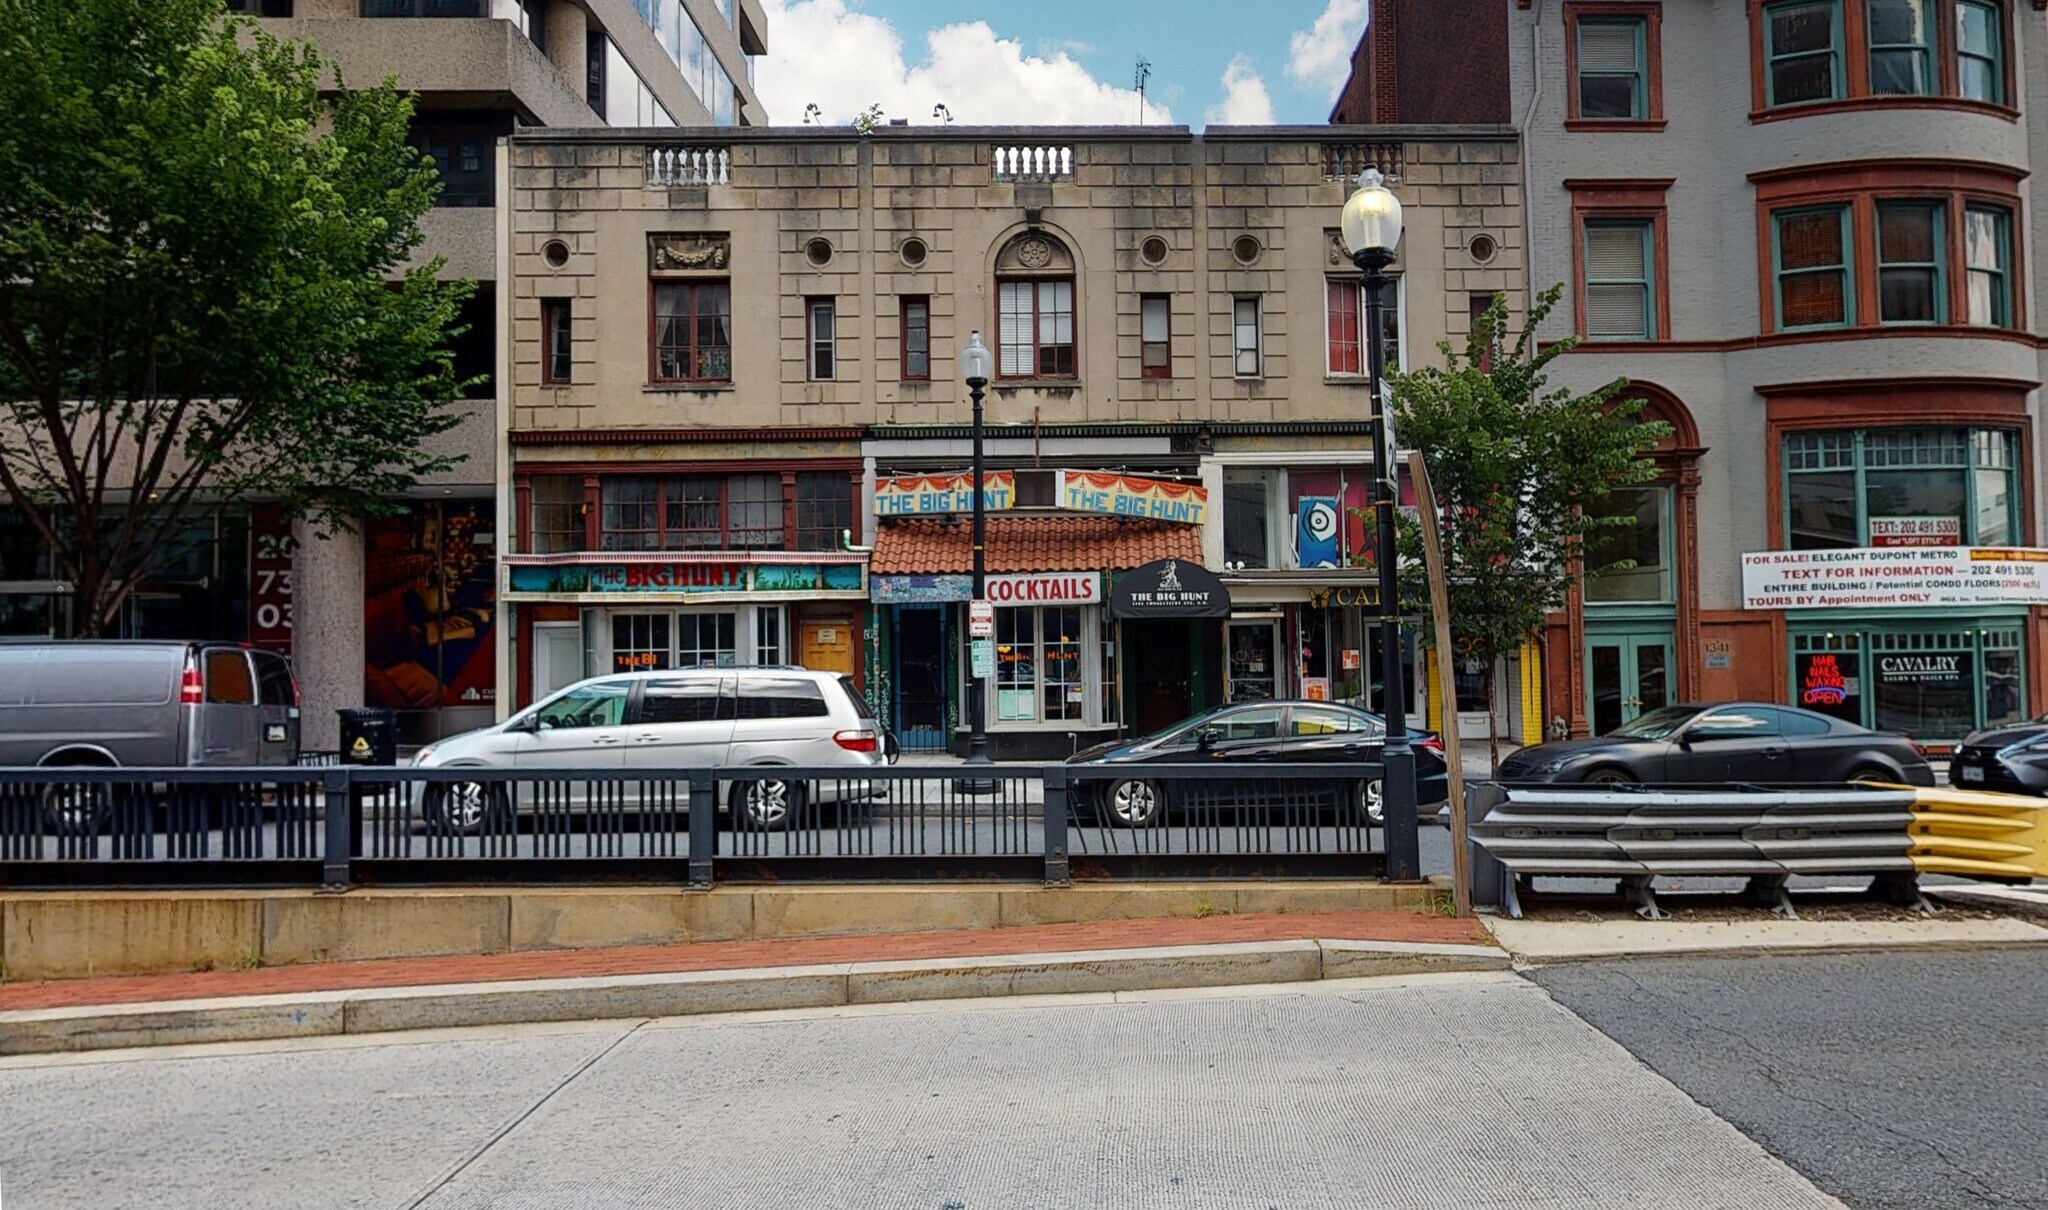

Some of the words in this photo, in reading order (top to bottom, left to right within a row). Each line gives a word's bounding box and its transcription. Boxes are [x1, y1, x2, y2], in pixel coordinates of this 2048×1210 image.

[876, 494, 914, 513] THE
[919, 492, 950, 512] BIG
[1068, 488, 1109, 513] THE
[1114, 494, 1147, 516] BIG
[1151, 499, 1203, 523] HUNT
[1872, 521, 1898, 534] TEXT:
[1901, 520, 1916, 533] 202
[1745, 556, 1770, 565] FOR
[1774, 554, 1809, 564] SALE!
[1812, 552, 1866, 562] ELEGANT
[1870, 551, 1917, 560] DUPONT
[1921, 550, 1958, 559] METRO
[598, 569, 625, 584] THE
[626, 564, 670, 587] BIG
[674, 562, 741, 586] HUNT
[1782, 569, 1820, 579] TEXT
[1826, 568, 1855, 577] FOR
[1860, 565, 1953, 577] INFORMATION
[1971, 565, 1991, 575] 202
[986, 578, 1093, 601] COCKTAILS
[1764, 583, 1807, 592] ENTIRE
[1811, 581, 1867, 591] BUILDING
[1876, 580, 1923, 589] Potential
[1925, 579, 1961, 588] CONDO
[1964, 579, 2001, 588] FLOORS
[1130, 592, 1152, 601] THE
[1156, 592, 1176, 601] BIG
[1181, 592, 1210, 601] HUNT
[1748, 596, 1792, 606] TOURS
[1796, 596, 1814, 605] BY
[1819, 595, 1896, 606] Appointment
[1900, 593, 1931, 602] ONLY
[1705, 642, 1730, 653] 1341
[617, 655, 640, 666] THE
[1047, 651, 1079, 661] HUNT
[1812, 654, 1836, 666] HAIR
[1881, 656, 1959, 672] CAVALRY
[1810, 666, 1839, 677] NAILS
[1803, 690, 1843, 704] OPEN
